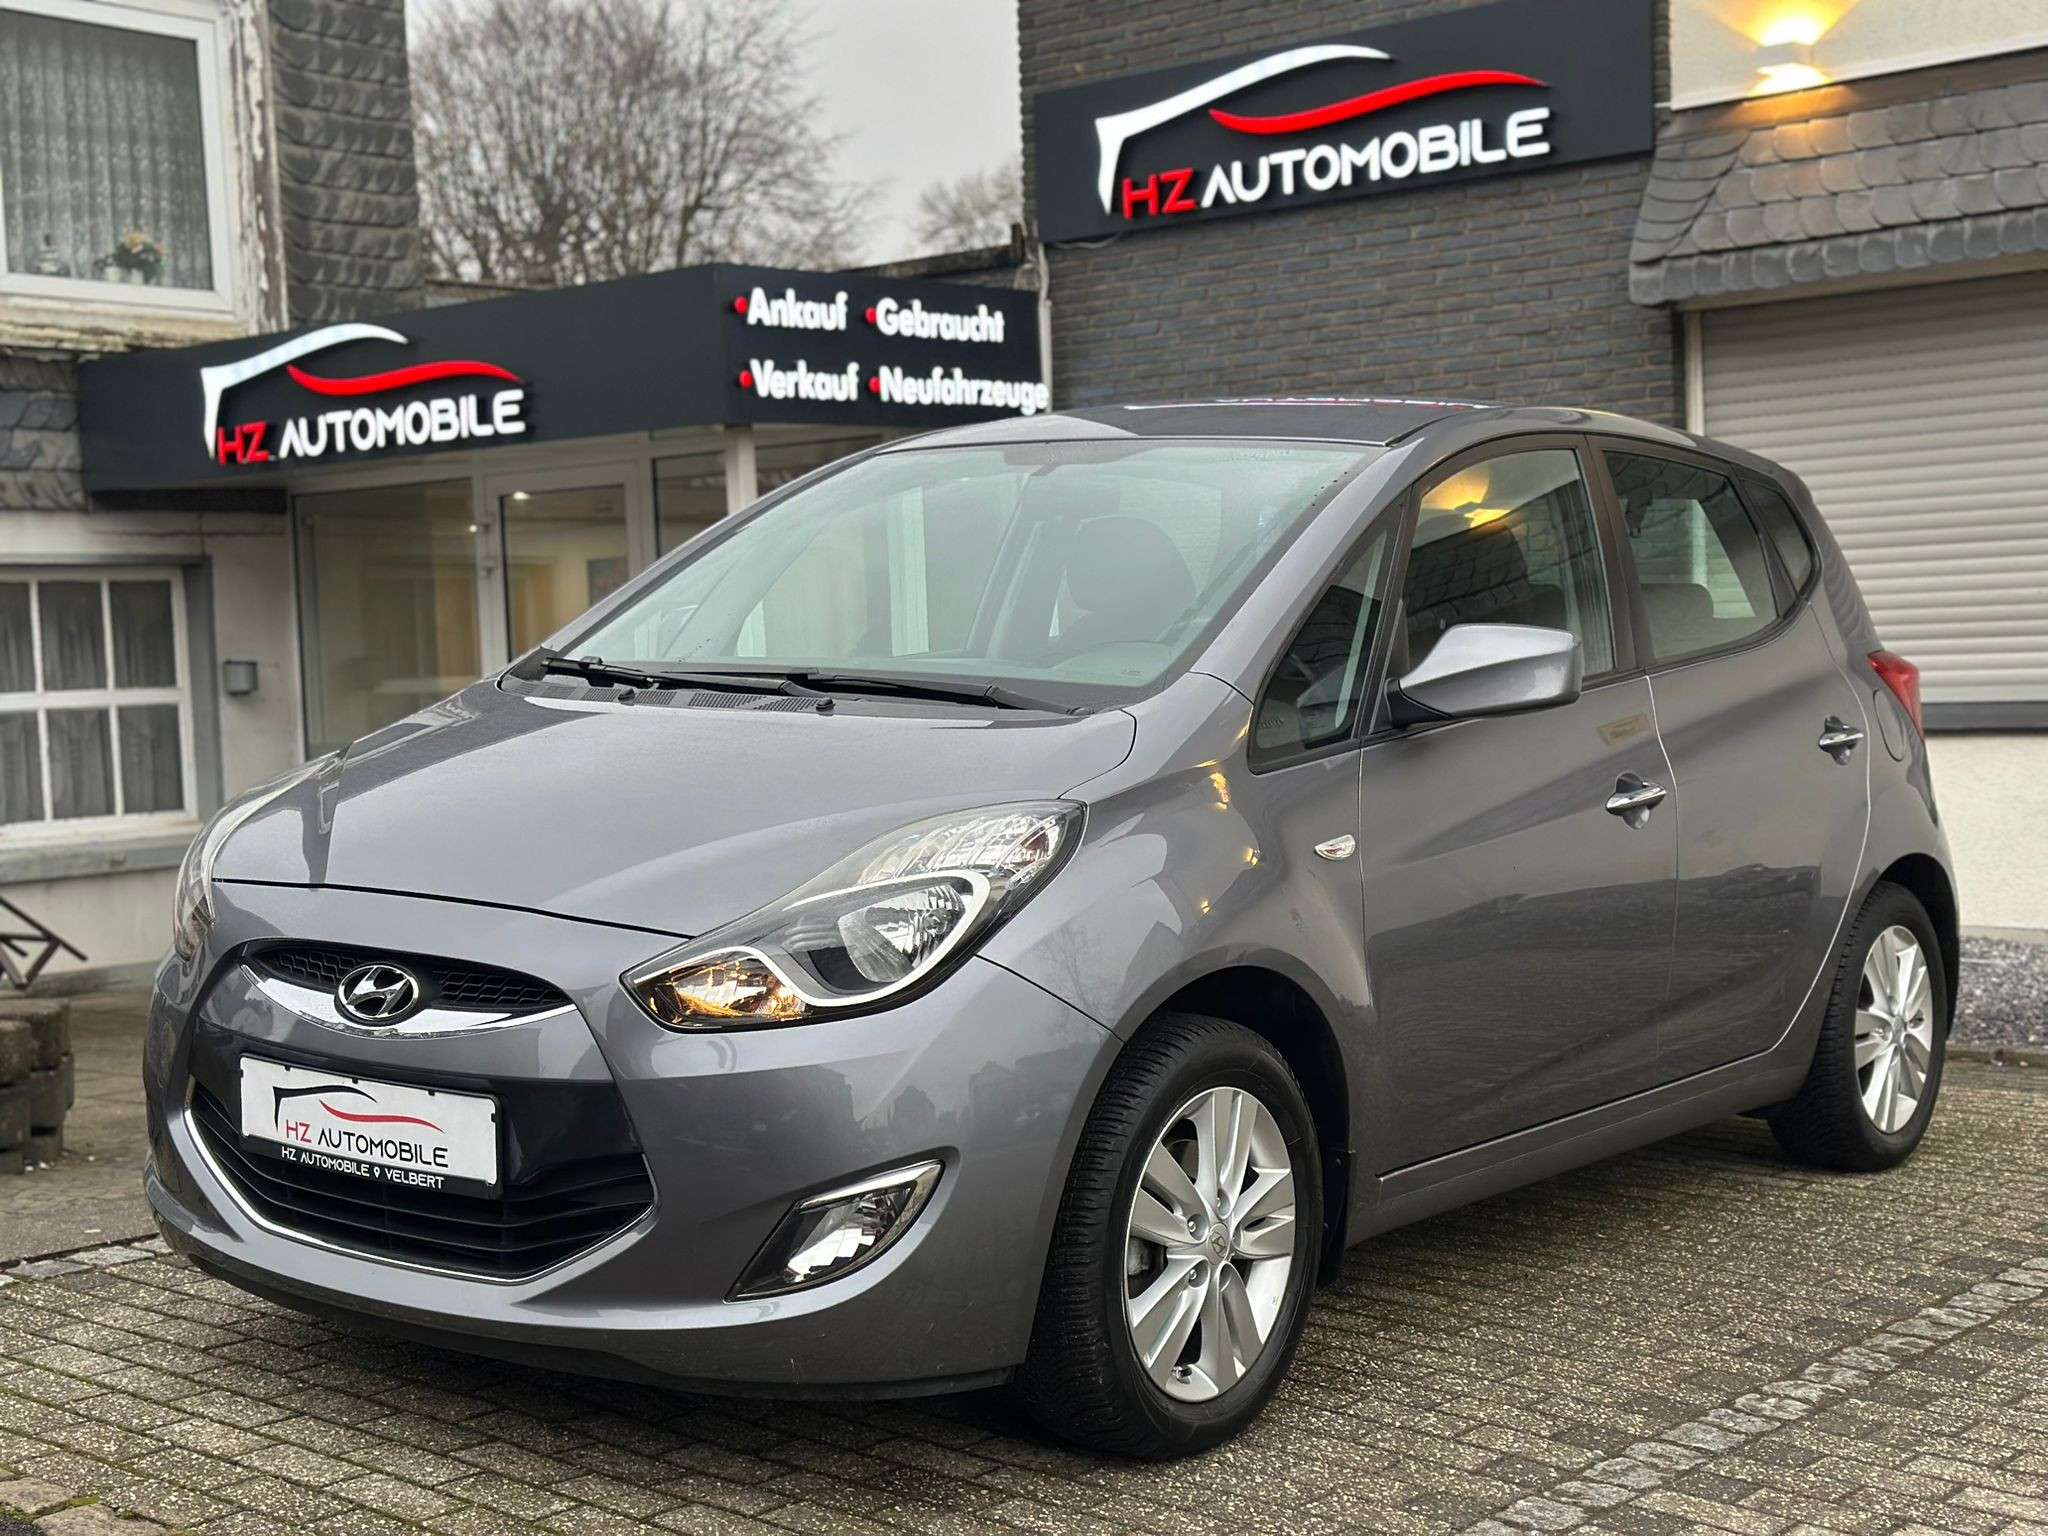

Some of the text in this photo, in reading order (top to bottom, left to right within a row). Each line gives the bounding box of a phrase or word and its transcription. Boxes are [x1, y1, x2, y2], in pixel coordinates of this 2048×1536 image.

[1121, 106, 1551, 219] HZ AUTOMOBILE
[746, 286, 1005, 343] Ankauf Gebraucht
[749, 358, 1050, 416] Verkauf Neufahrzeuge
[217, 388, 526, 467] HZ AUTOMOBILE
[281, 1145, 445, 1189] HZ AUTOMOBILE VELBERT
[285, 1119, 449, 1168] HZ AUTOMOBILE
